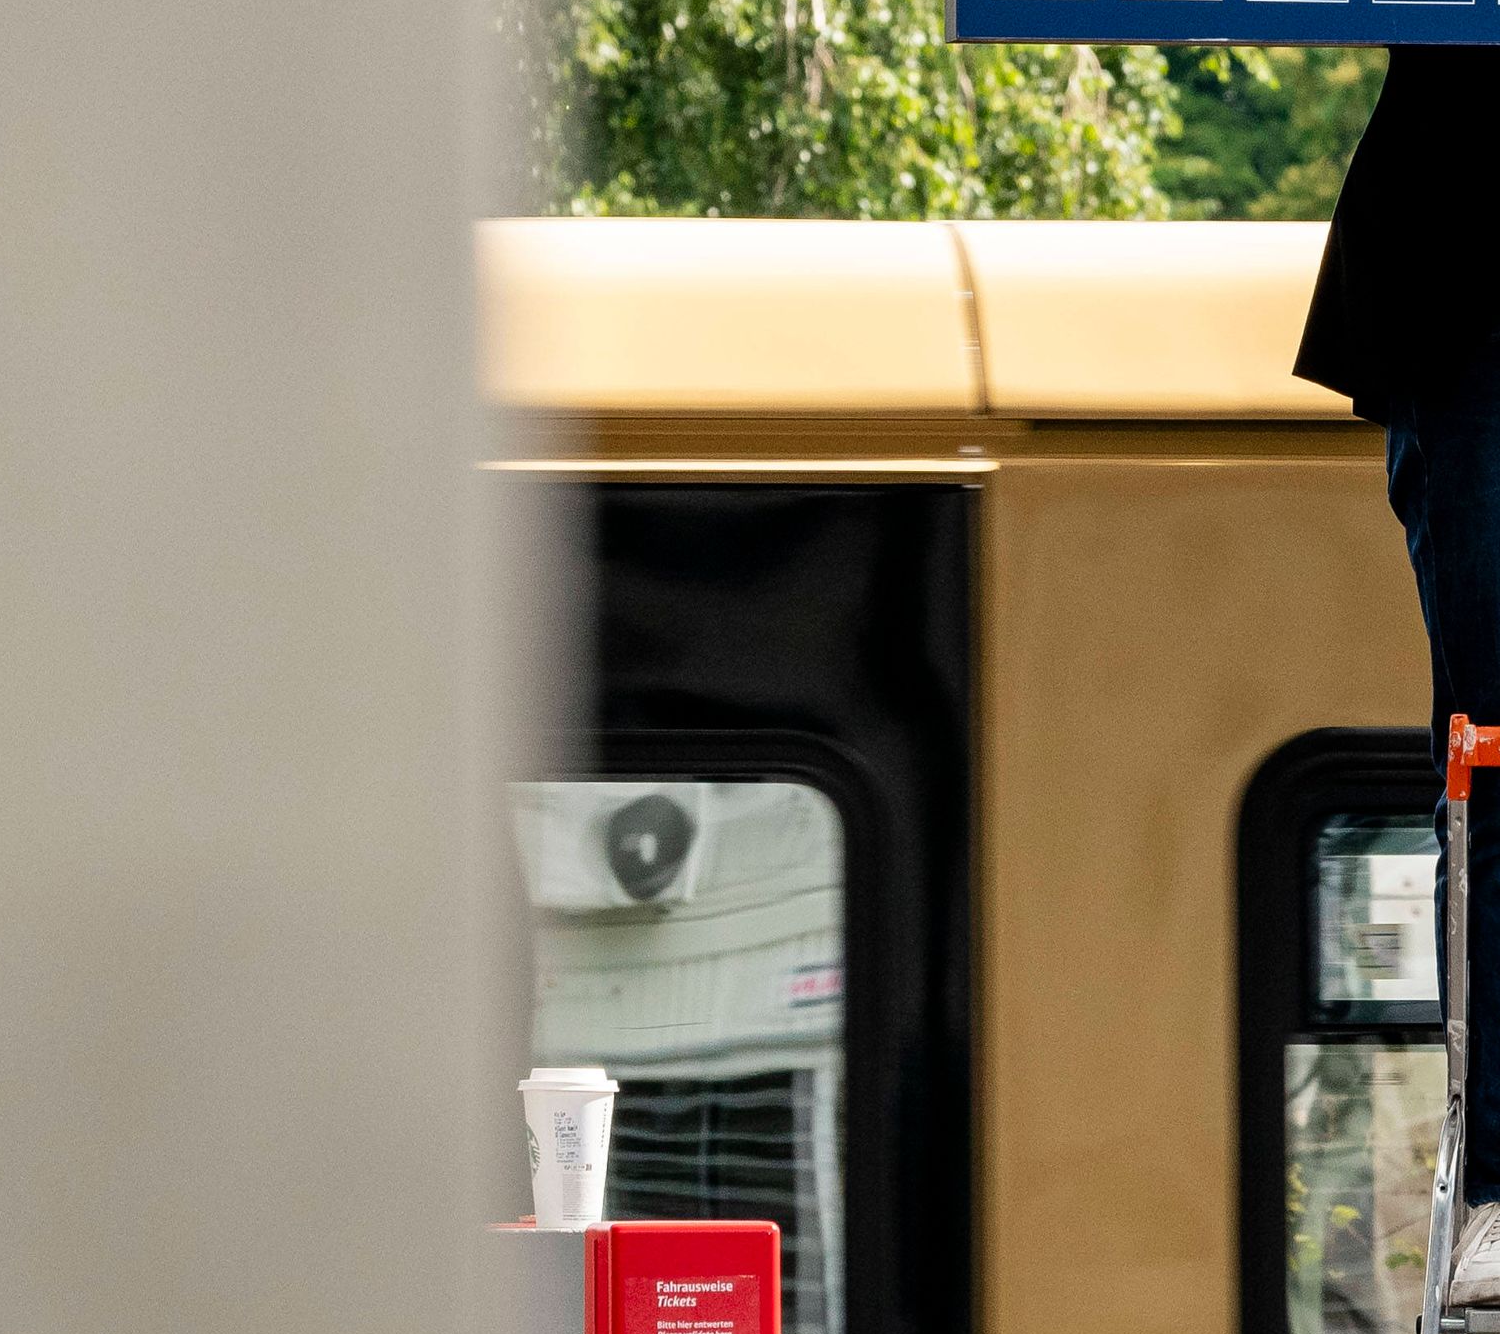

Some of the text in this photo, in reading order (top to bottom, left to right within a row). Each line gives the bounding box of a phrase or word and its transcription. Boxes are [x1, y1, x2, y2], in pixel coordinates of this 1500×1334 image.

[656, 1280, 734, 1293] Fahrausweise
[657, 1295, 697, 1307] Tickets
[657, 1320, 734, 1329] Bitte hier entwerten
